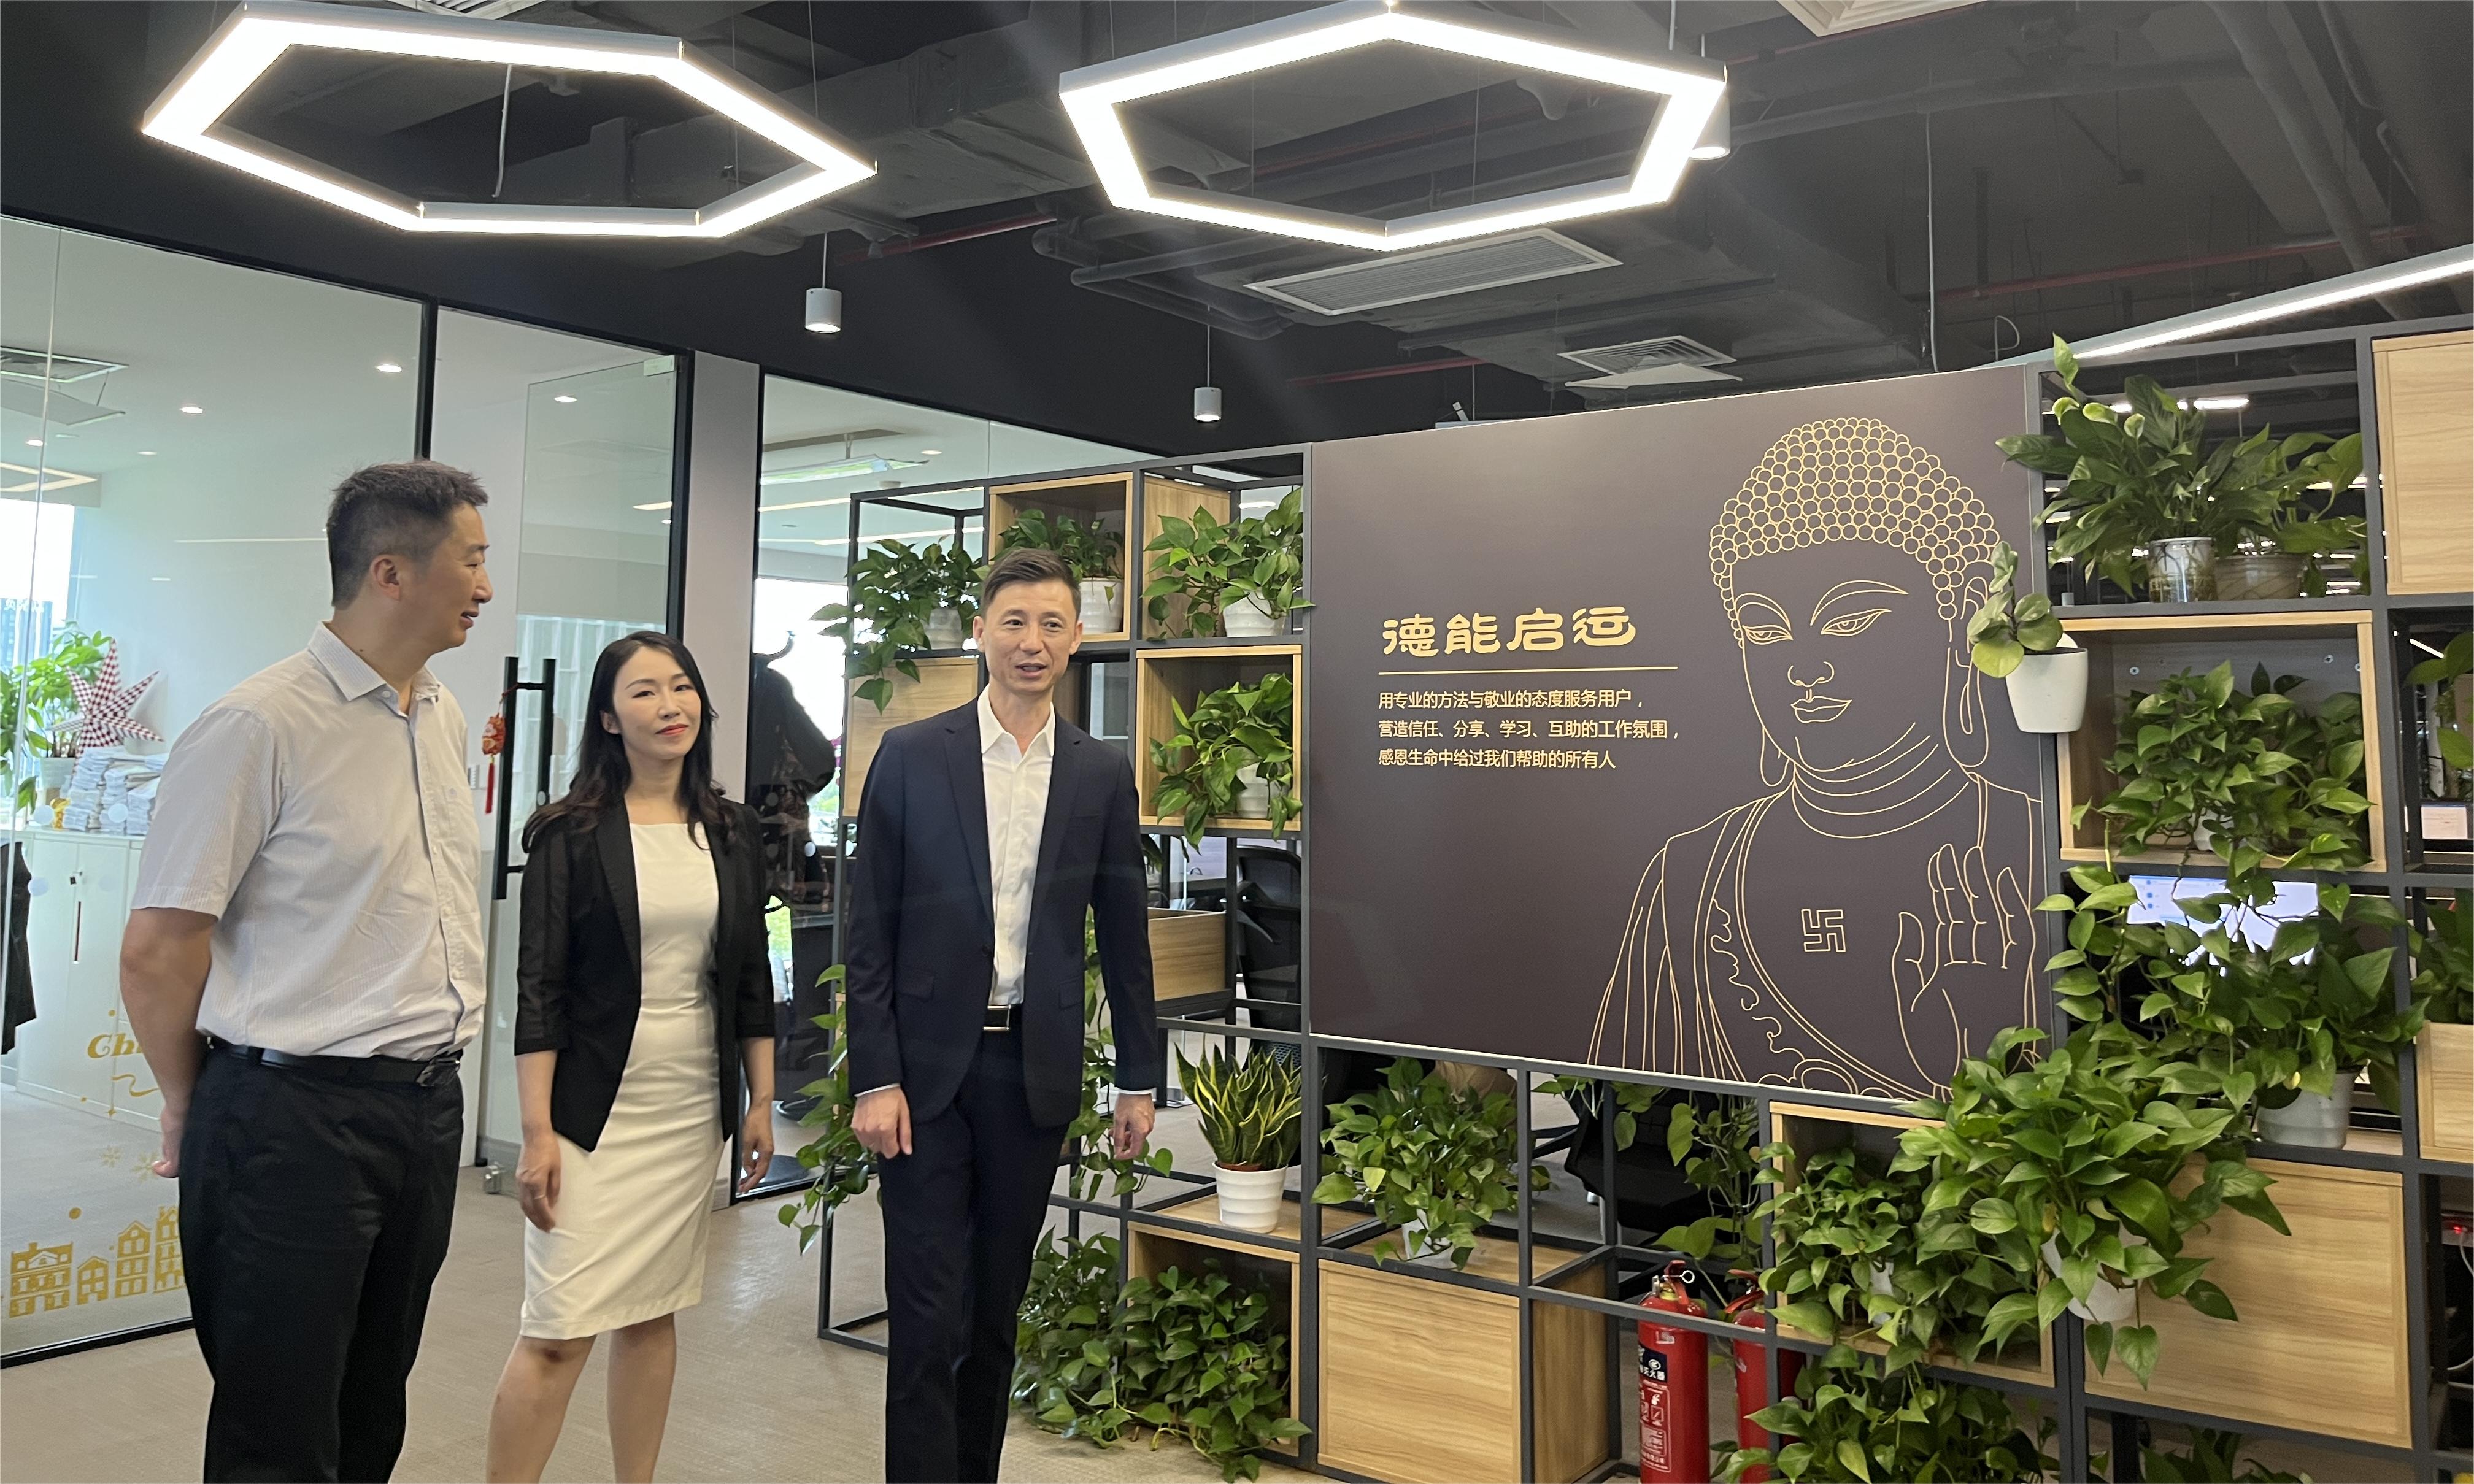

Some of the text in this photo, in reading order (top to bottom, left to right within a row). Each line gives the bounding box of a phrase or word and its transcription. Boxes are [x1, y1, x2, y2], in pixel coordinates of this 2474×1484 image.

[1382, 606, 1636, 657] 德能启运
[1378, 689, 1642, 709] 用专业的方法与敬业的态度服务用户，
[1378, 719, 1678, 739] 营造信任、分享、学习、互助的工作氛围，
[1378, 748, 1616, 769] 感恩生命中给过我们帮助的所有人
[87, 1033, 143, 1059] Ch
